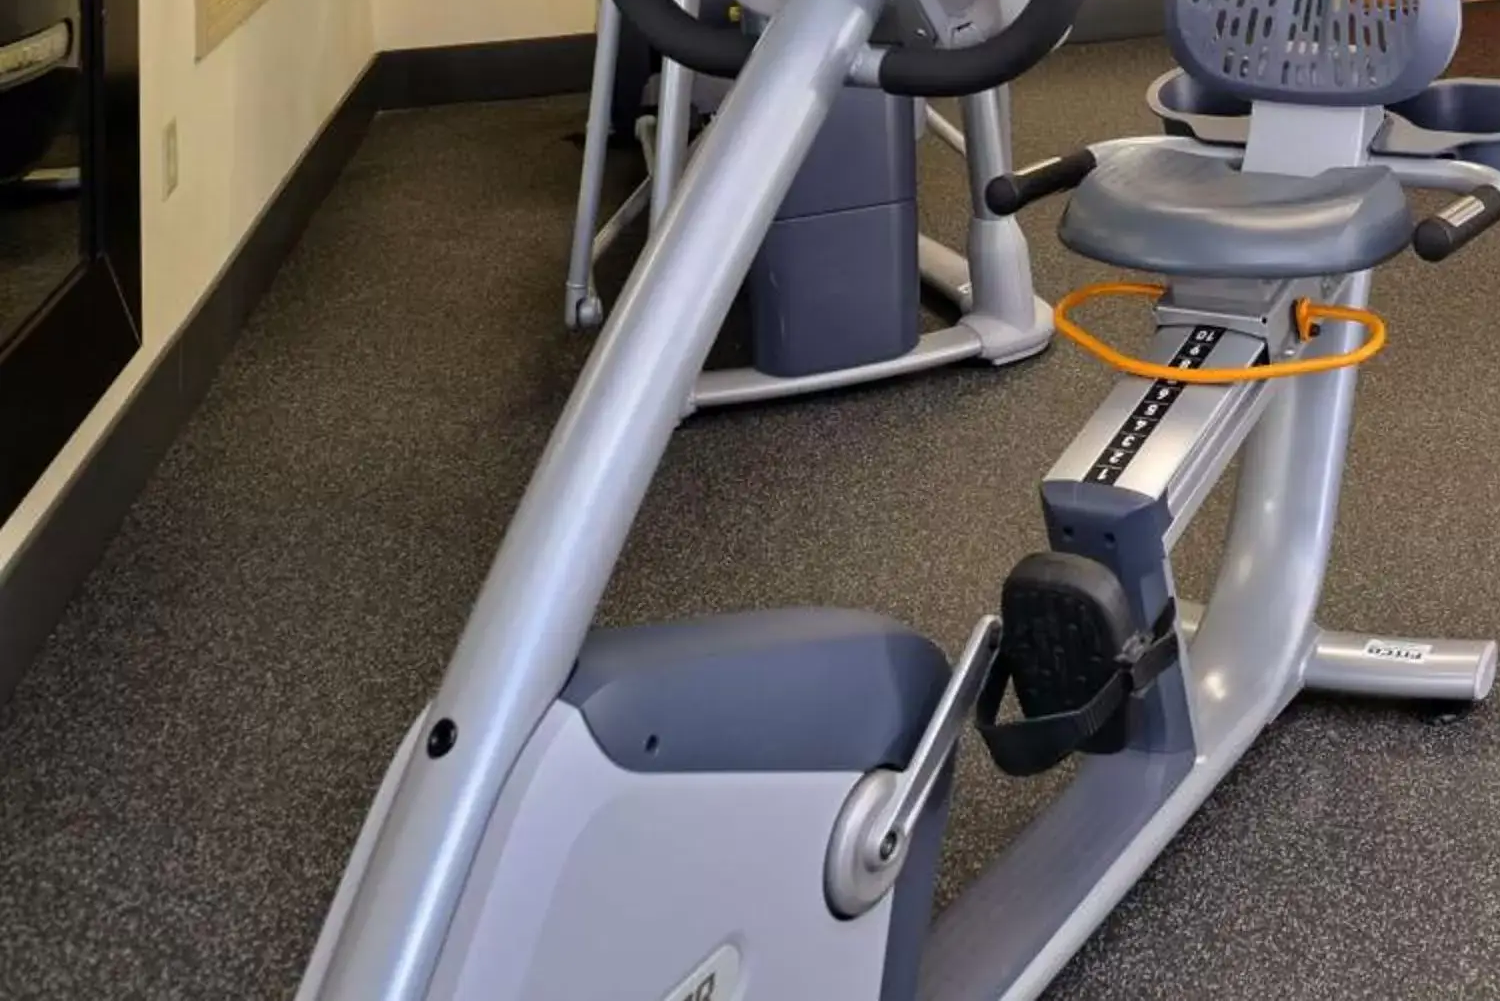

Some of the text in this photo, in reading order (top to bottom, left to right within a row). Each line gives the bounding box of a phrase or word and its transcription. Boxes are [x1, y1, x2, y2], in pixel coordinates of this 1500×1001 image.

[1195, 330, 1215, 342] 10
[1189, 344, 1201, 356] 9
[1156, 388, 1170, 400] 6
[1144, 404, 1158, 416] 5
[1134, 420, 1148, 431] 4
[1121, 435, 1135, 447] 3
[1109, 452, 1124, 464] 2
[1097, 468, 1109, 480] 1
